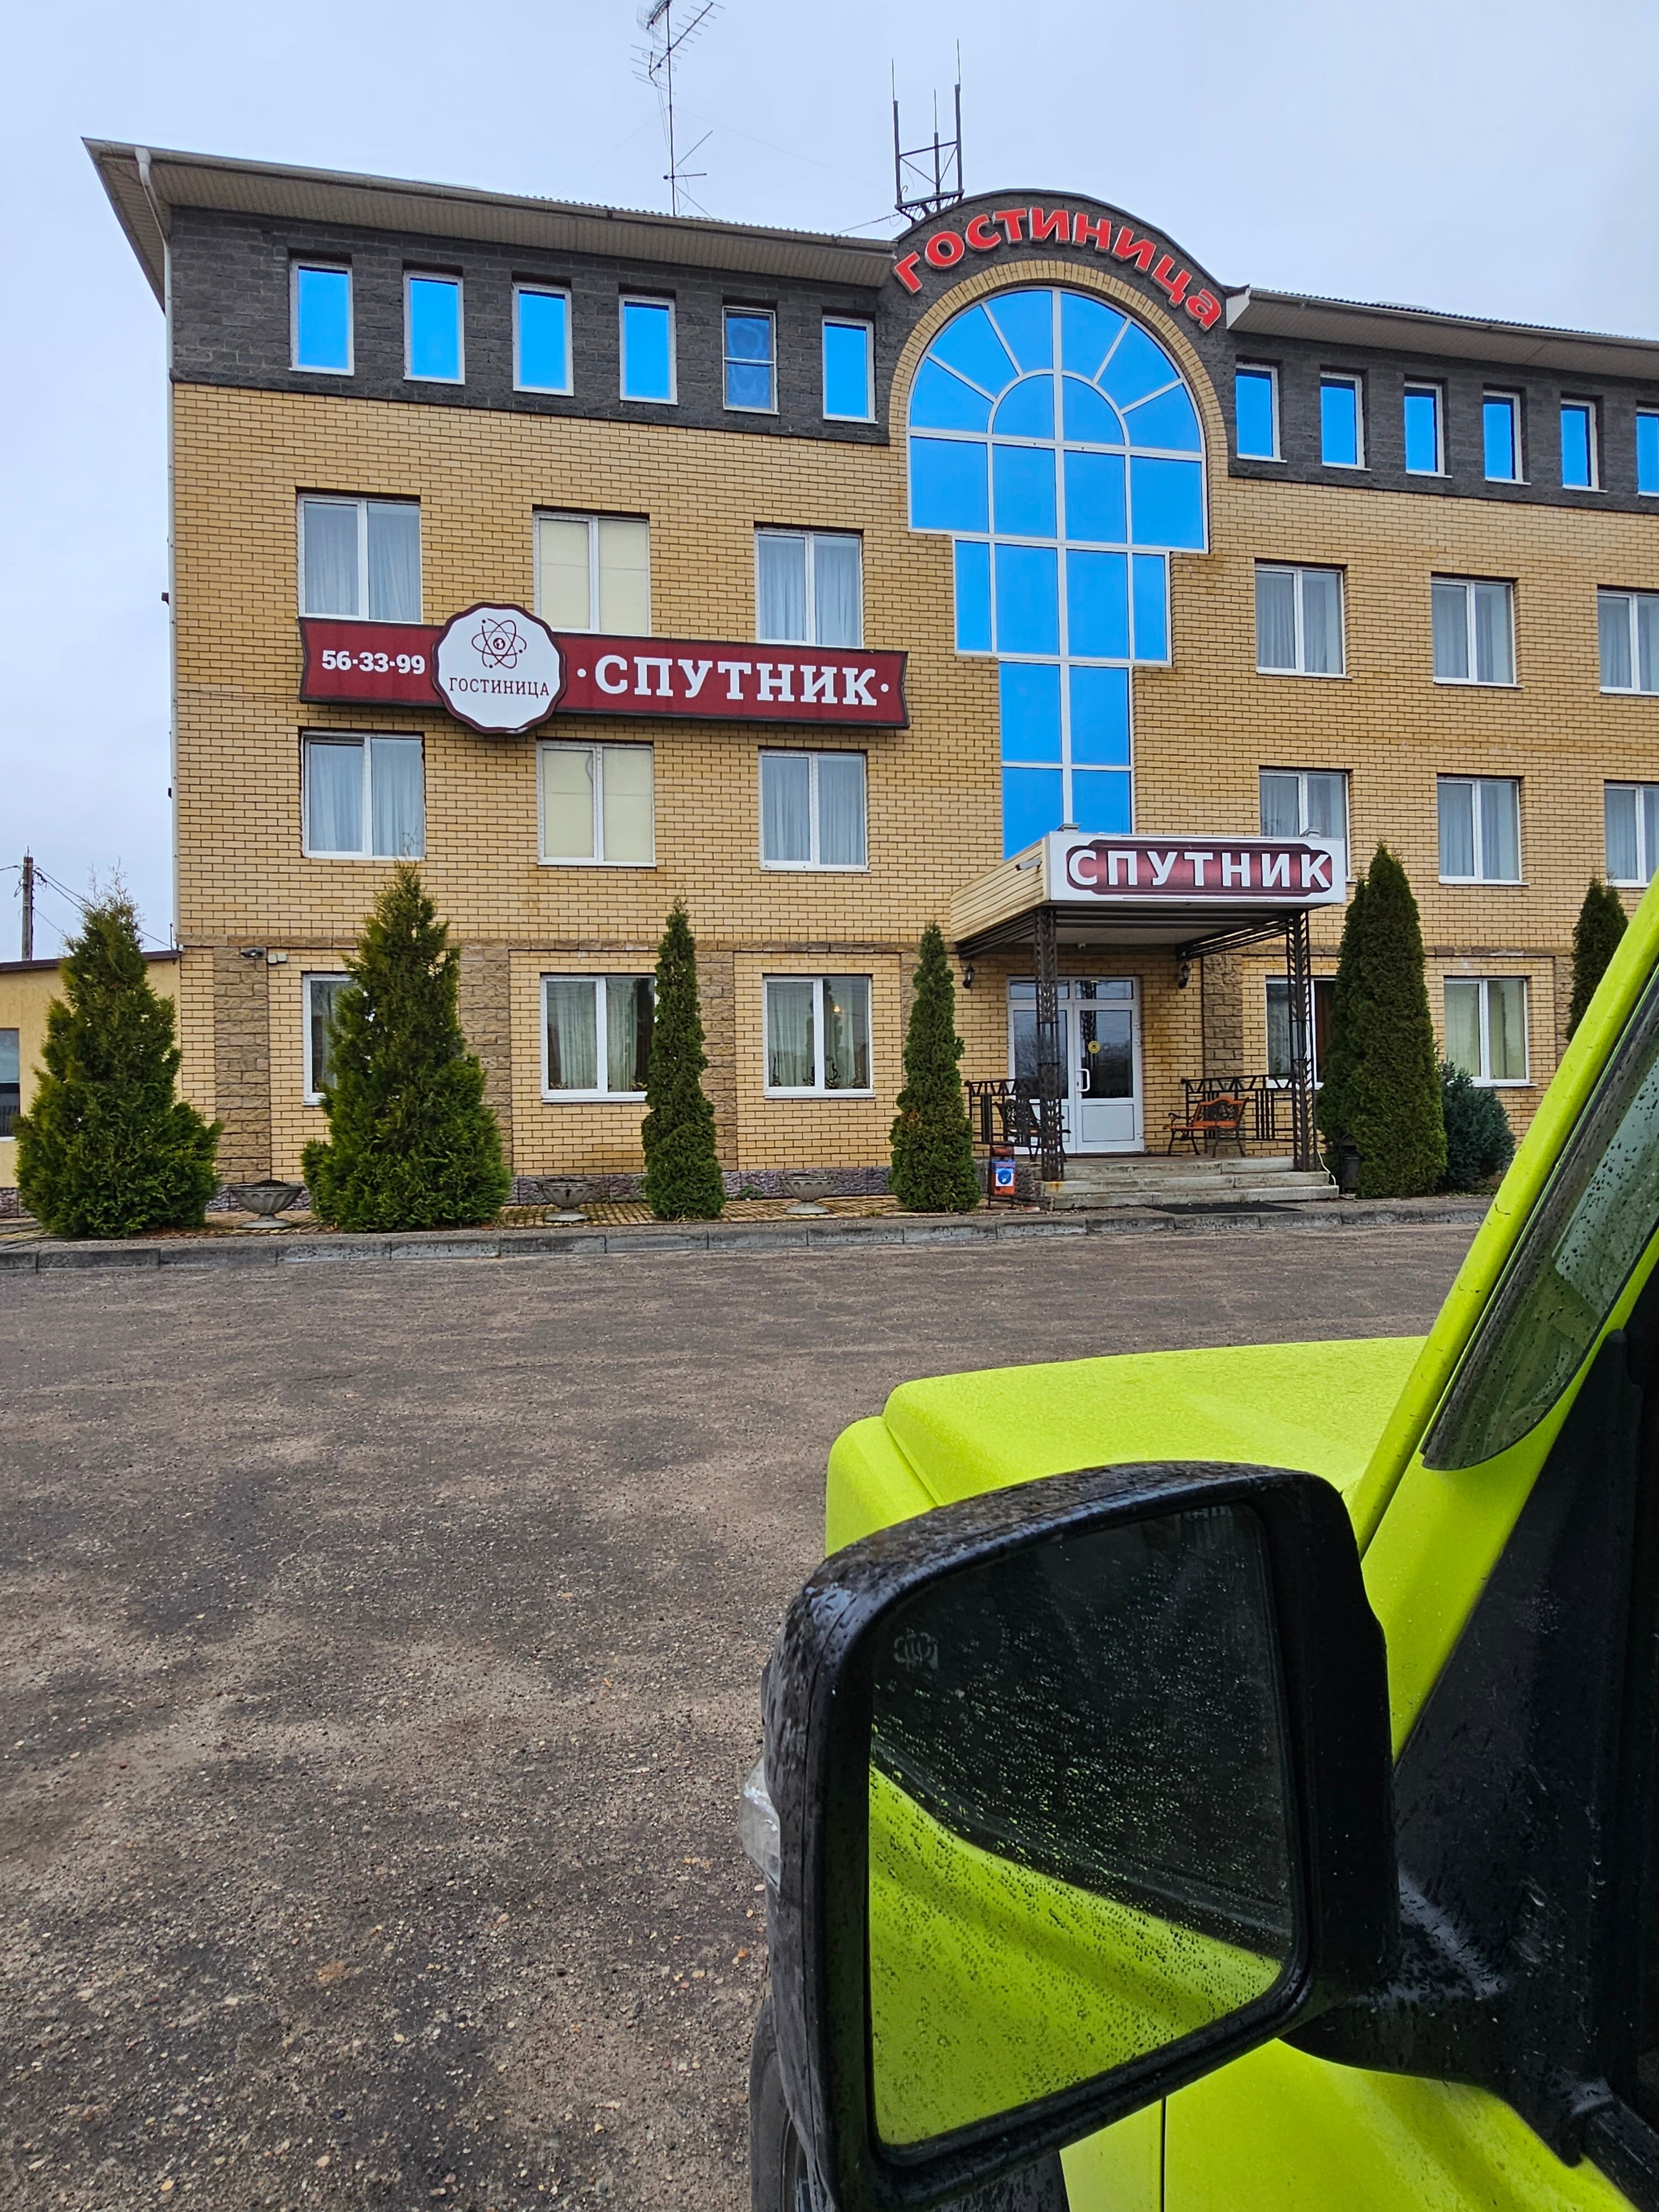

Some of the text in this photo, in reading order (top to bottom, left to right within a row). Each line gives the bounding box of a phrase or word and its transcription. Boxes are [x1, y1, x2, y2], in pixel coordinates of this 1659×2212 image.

[321, 649, 426, 675] 56-33-99
[448, 676, 550, 699] ГОСТИНИЦА
[594, 654, 878, 707] СПУТНИК
[1068, 849, 1331, 888] СПУТНИК
